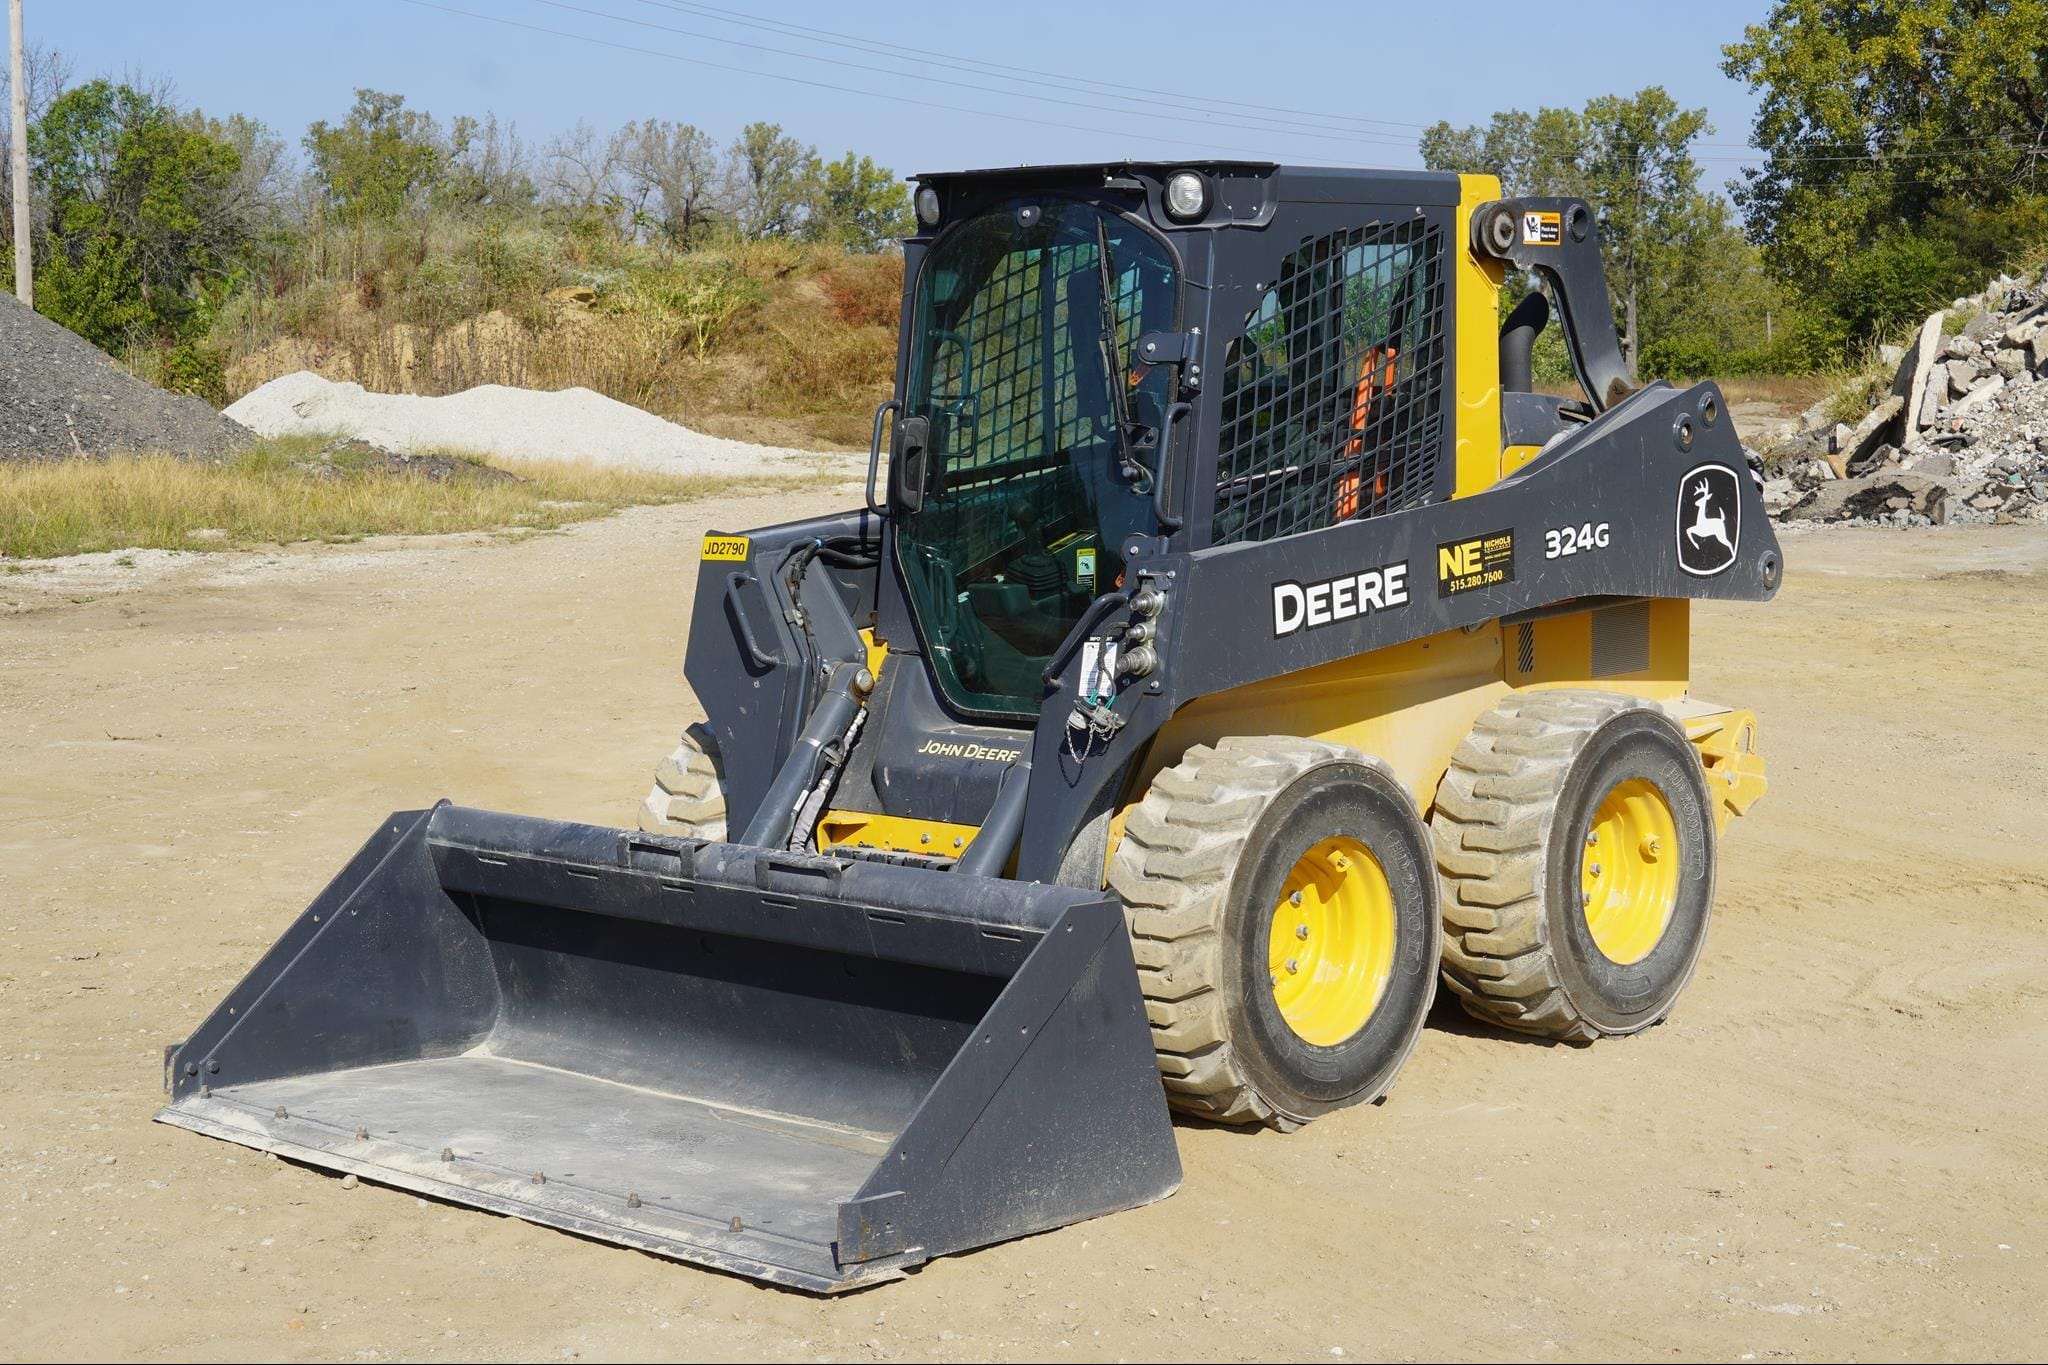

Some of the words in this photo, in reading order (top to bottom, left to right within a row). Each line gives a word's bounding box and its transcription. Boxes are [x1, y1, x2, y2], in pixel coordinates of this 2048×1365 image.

[704, 542, 745, 556] JD2790
[1484, 536, 1511, 549] NICHOLS
[1545, 522, 1609, 559] 324G
[1440, 540, 1482, 580] NE
[1450, 569, 1503, 592] 515.280.7600
[1274, 564, 1407, 635] DEERE
[918, 739, 964, 757] JOHN
[963, 743, 1020, 762] DEERE
